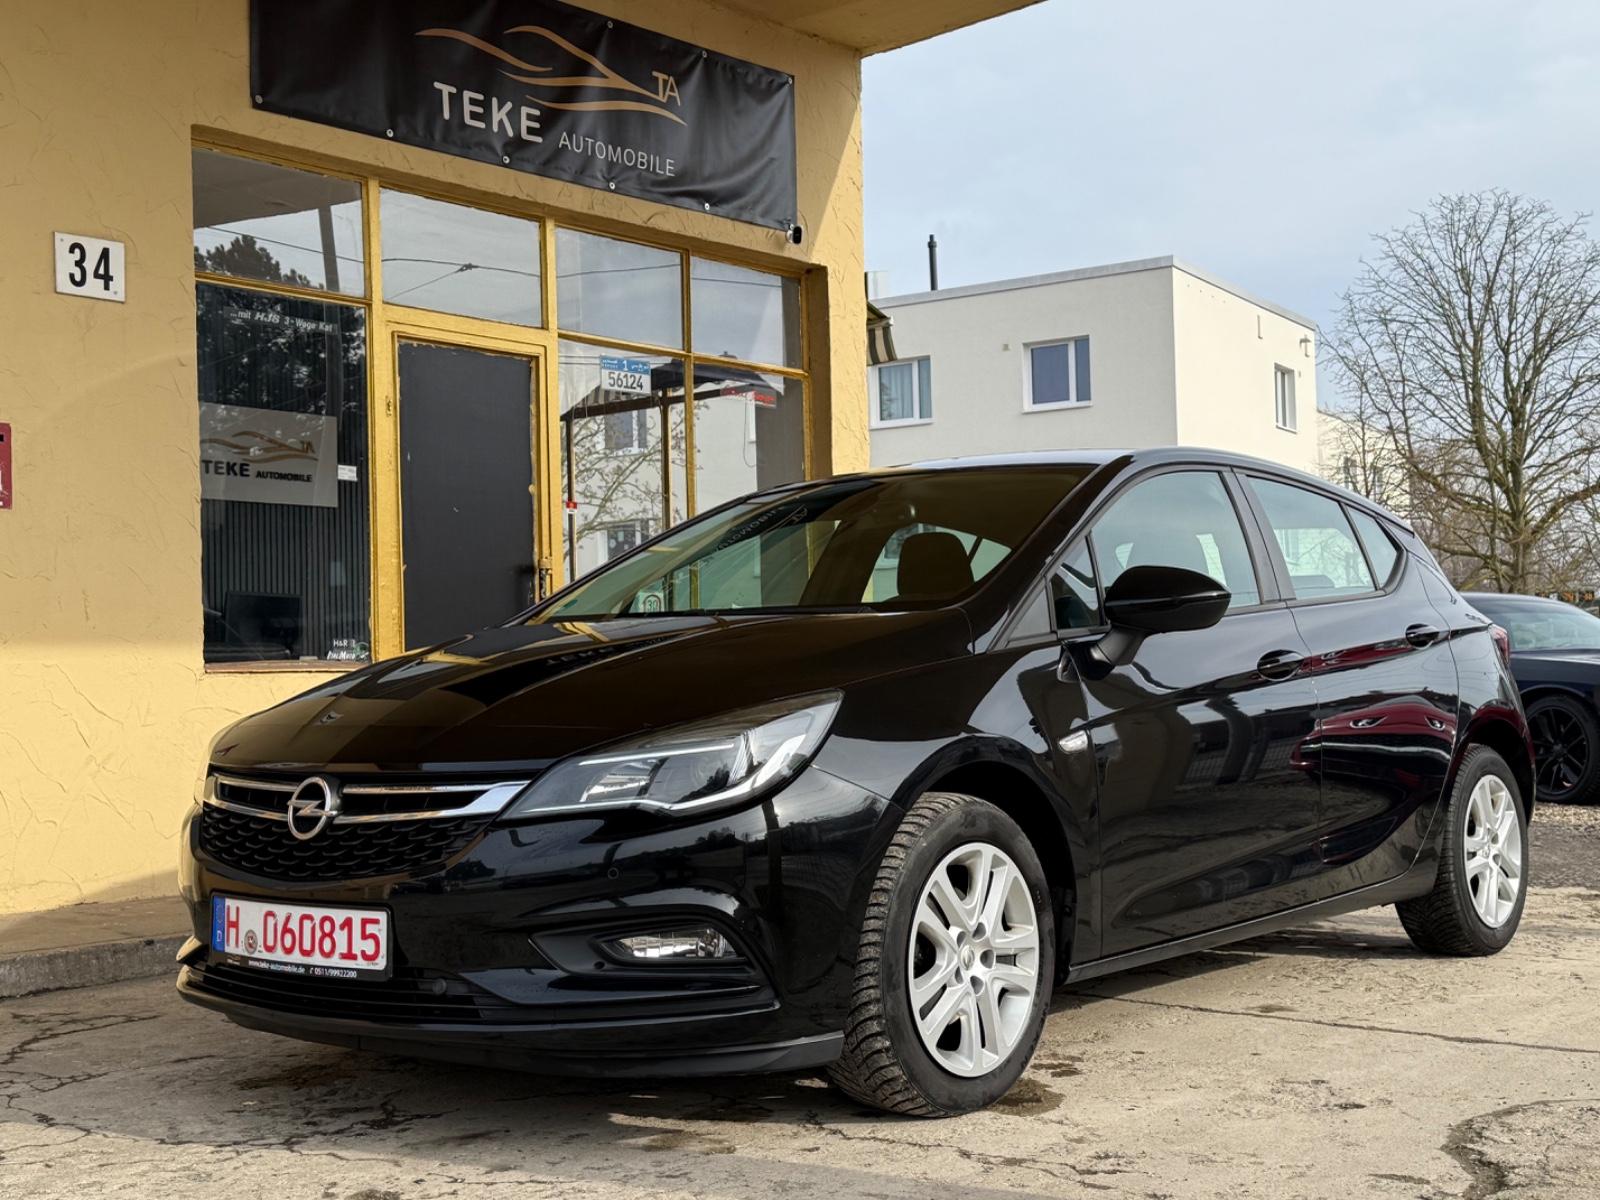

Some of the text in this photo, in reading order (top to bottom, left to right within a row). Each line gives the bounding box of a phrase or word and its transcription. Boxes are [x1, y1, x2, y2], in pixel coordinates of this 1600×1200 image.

[652, 71, 681, 106] TA
[433, 81, 676, 177] TEKE AUTOMOBILE
[68, 241, 114, 291] 34
[608, 371, 643, 391] 56124
[202, 460, 312, 482] TEKE AUTOMOBILE
[227, 905, 380, 962] H 060815
